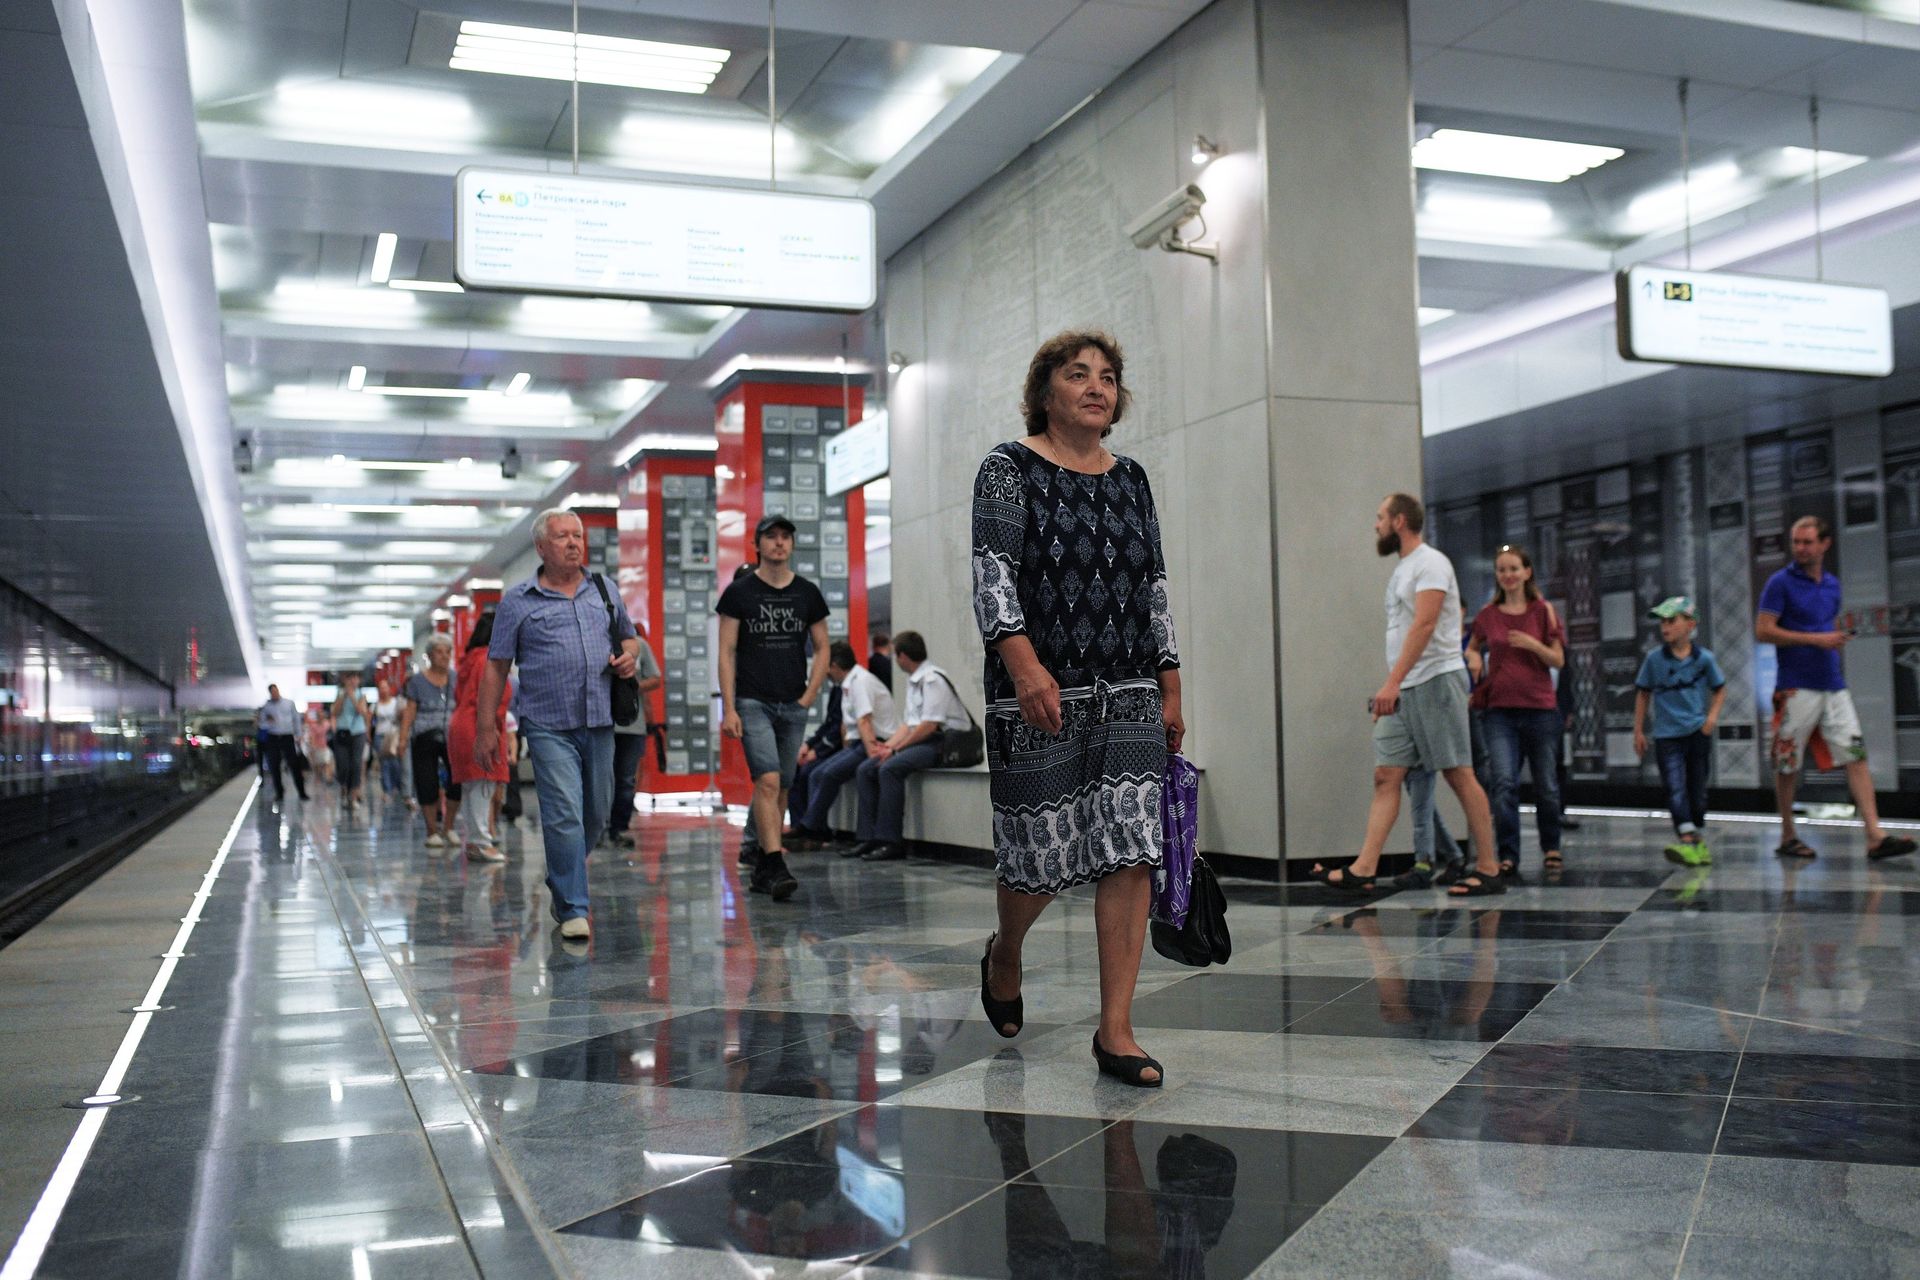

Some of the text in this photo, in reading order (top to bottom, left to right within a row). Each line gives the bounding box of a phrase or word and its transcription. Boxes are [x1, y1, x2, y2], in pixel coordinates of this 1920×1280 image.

[759, 603, 794, 620] New
[745, 616, 806, 634] York Cit
